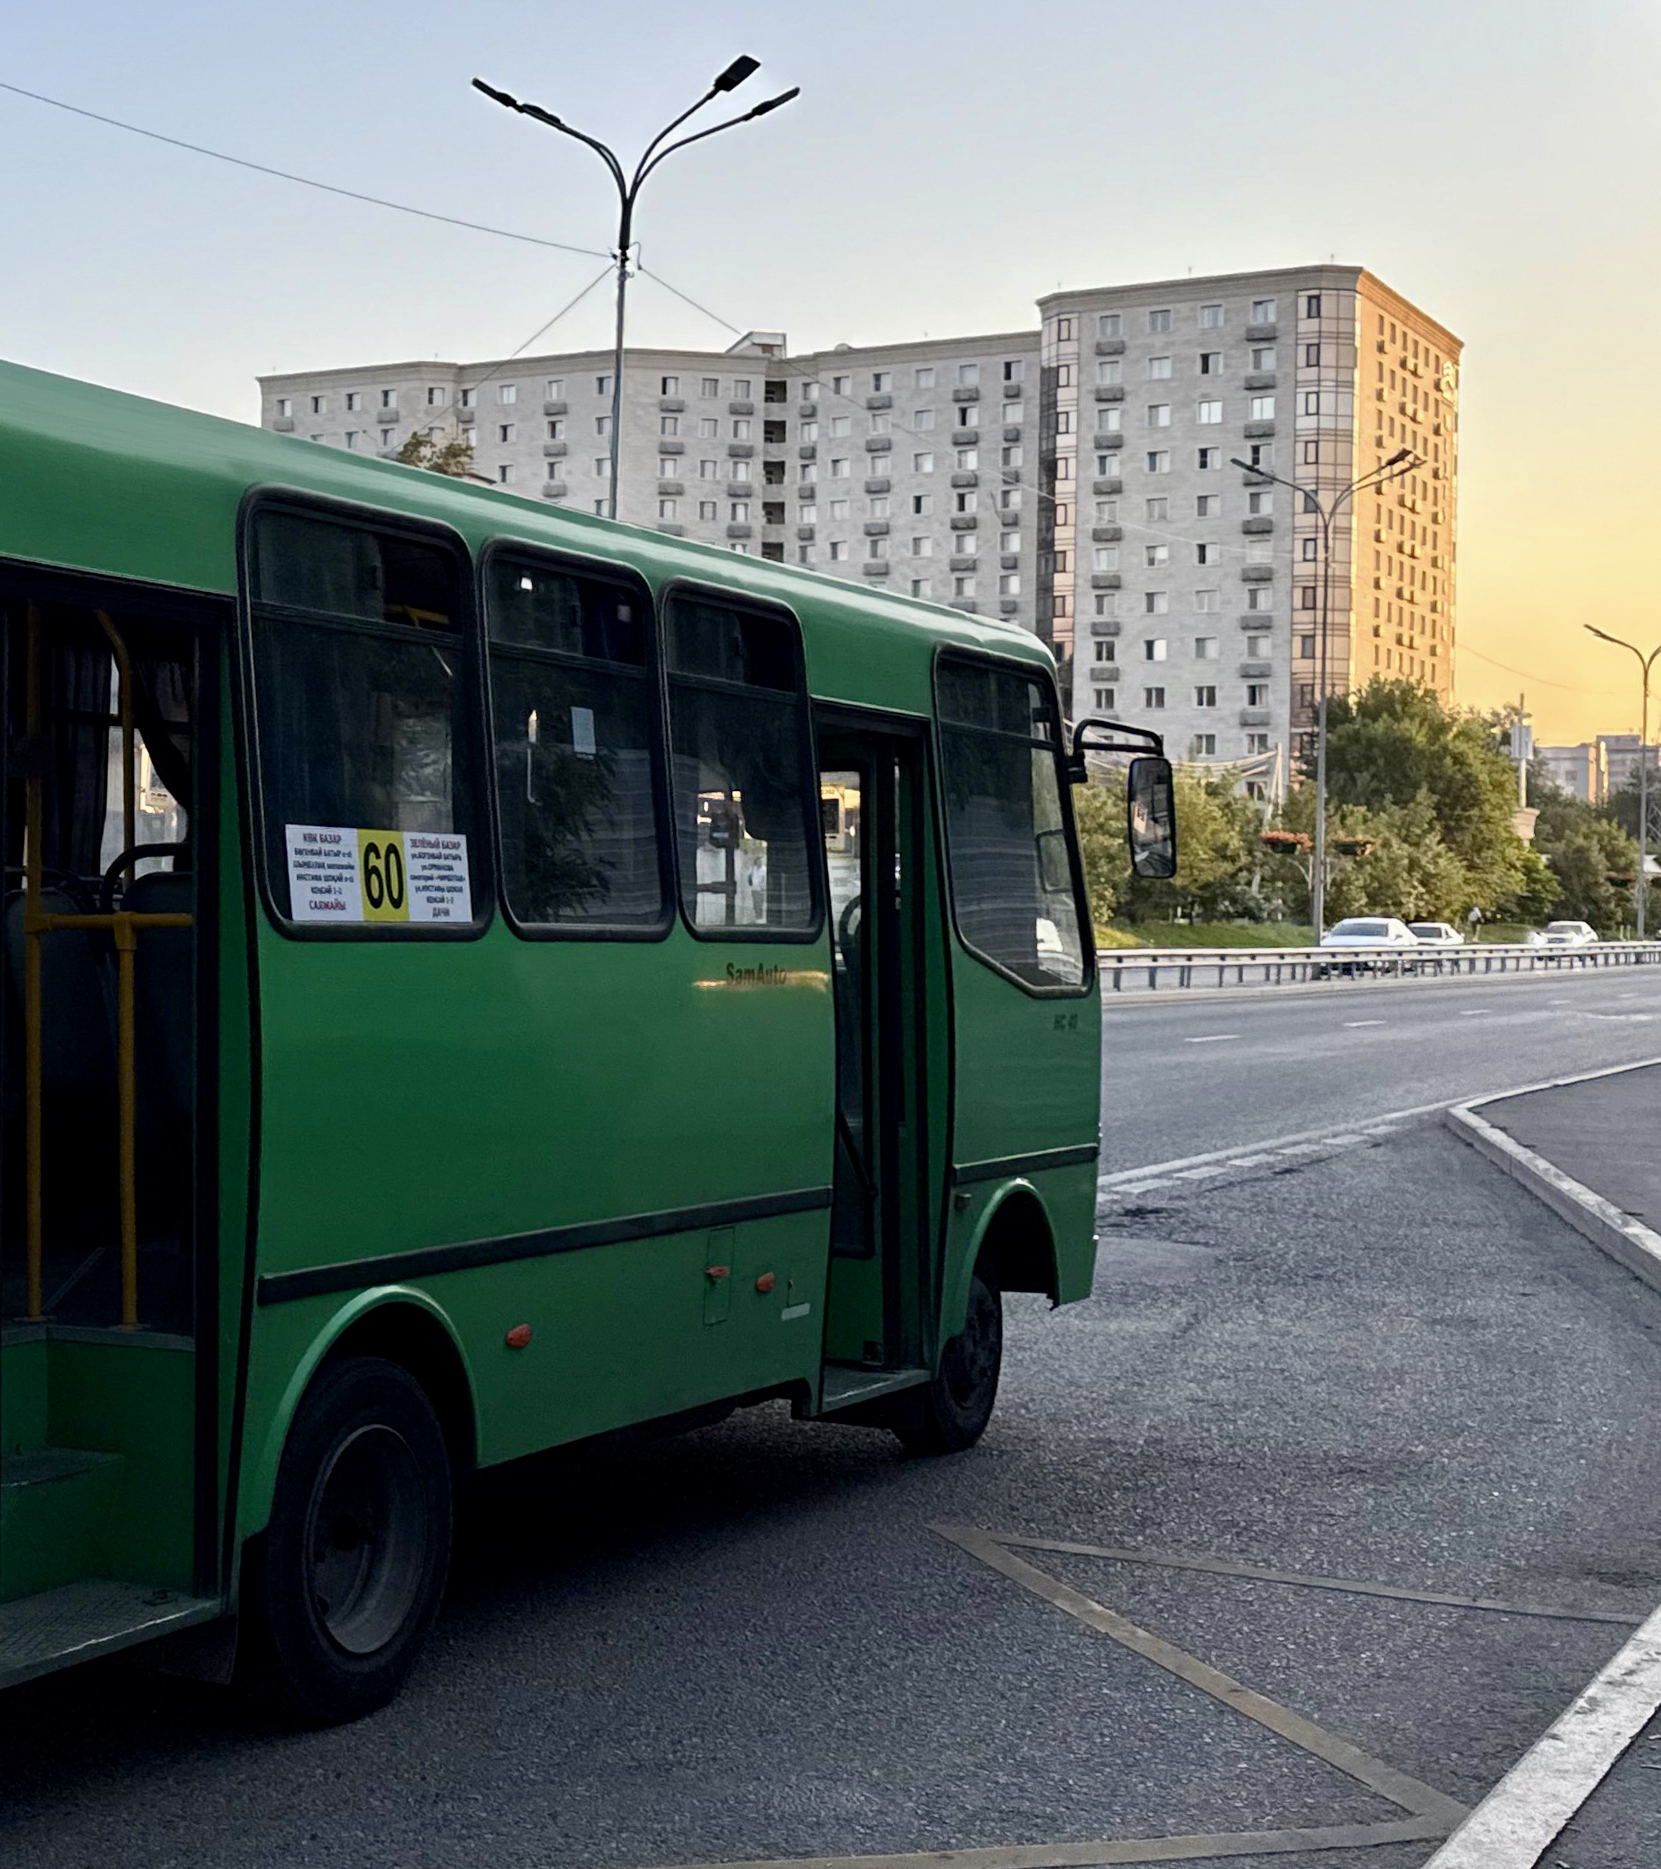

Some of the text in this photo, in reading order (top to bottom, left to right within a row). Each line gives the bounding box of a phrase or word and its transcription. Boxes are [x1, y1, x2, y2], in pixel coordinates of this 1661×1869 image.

[319, 834, 342, 844] БАЗАР
[441, 840, 461, 850] БАЗАР
[364, 842, 404, 910] 60
[726, 962, 787, 985] SamAuto
